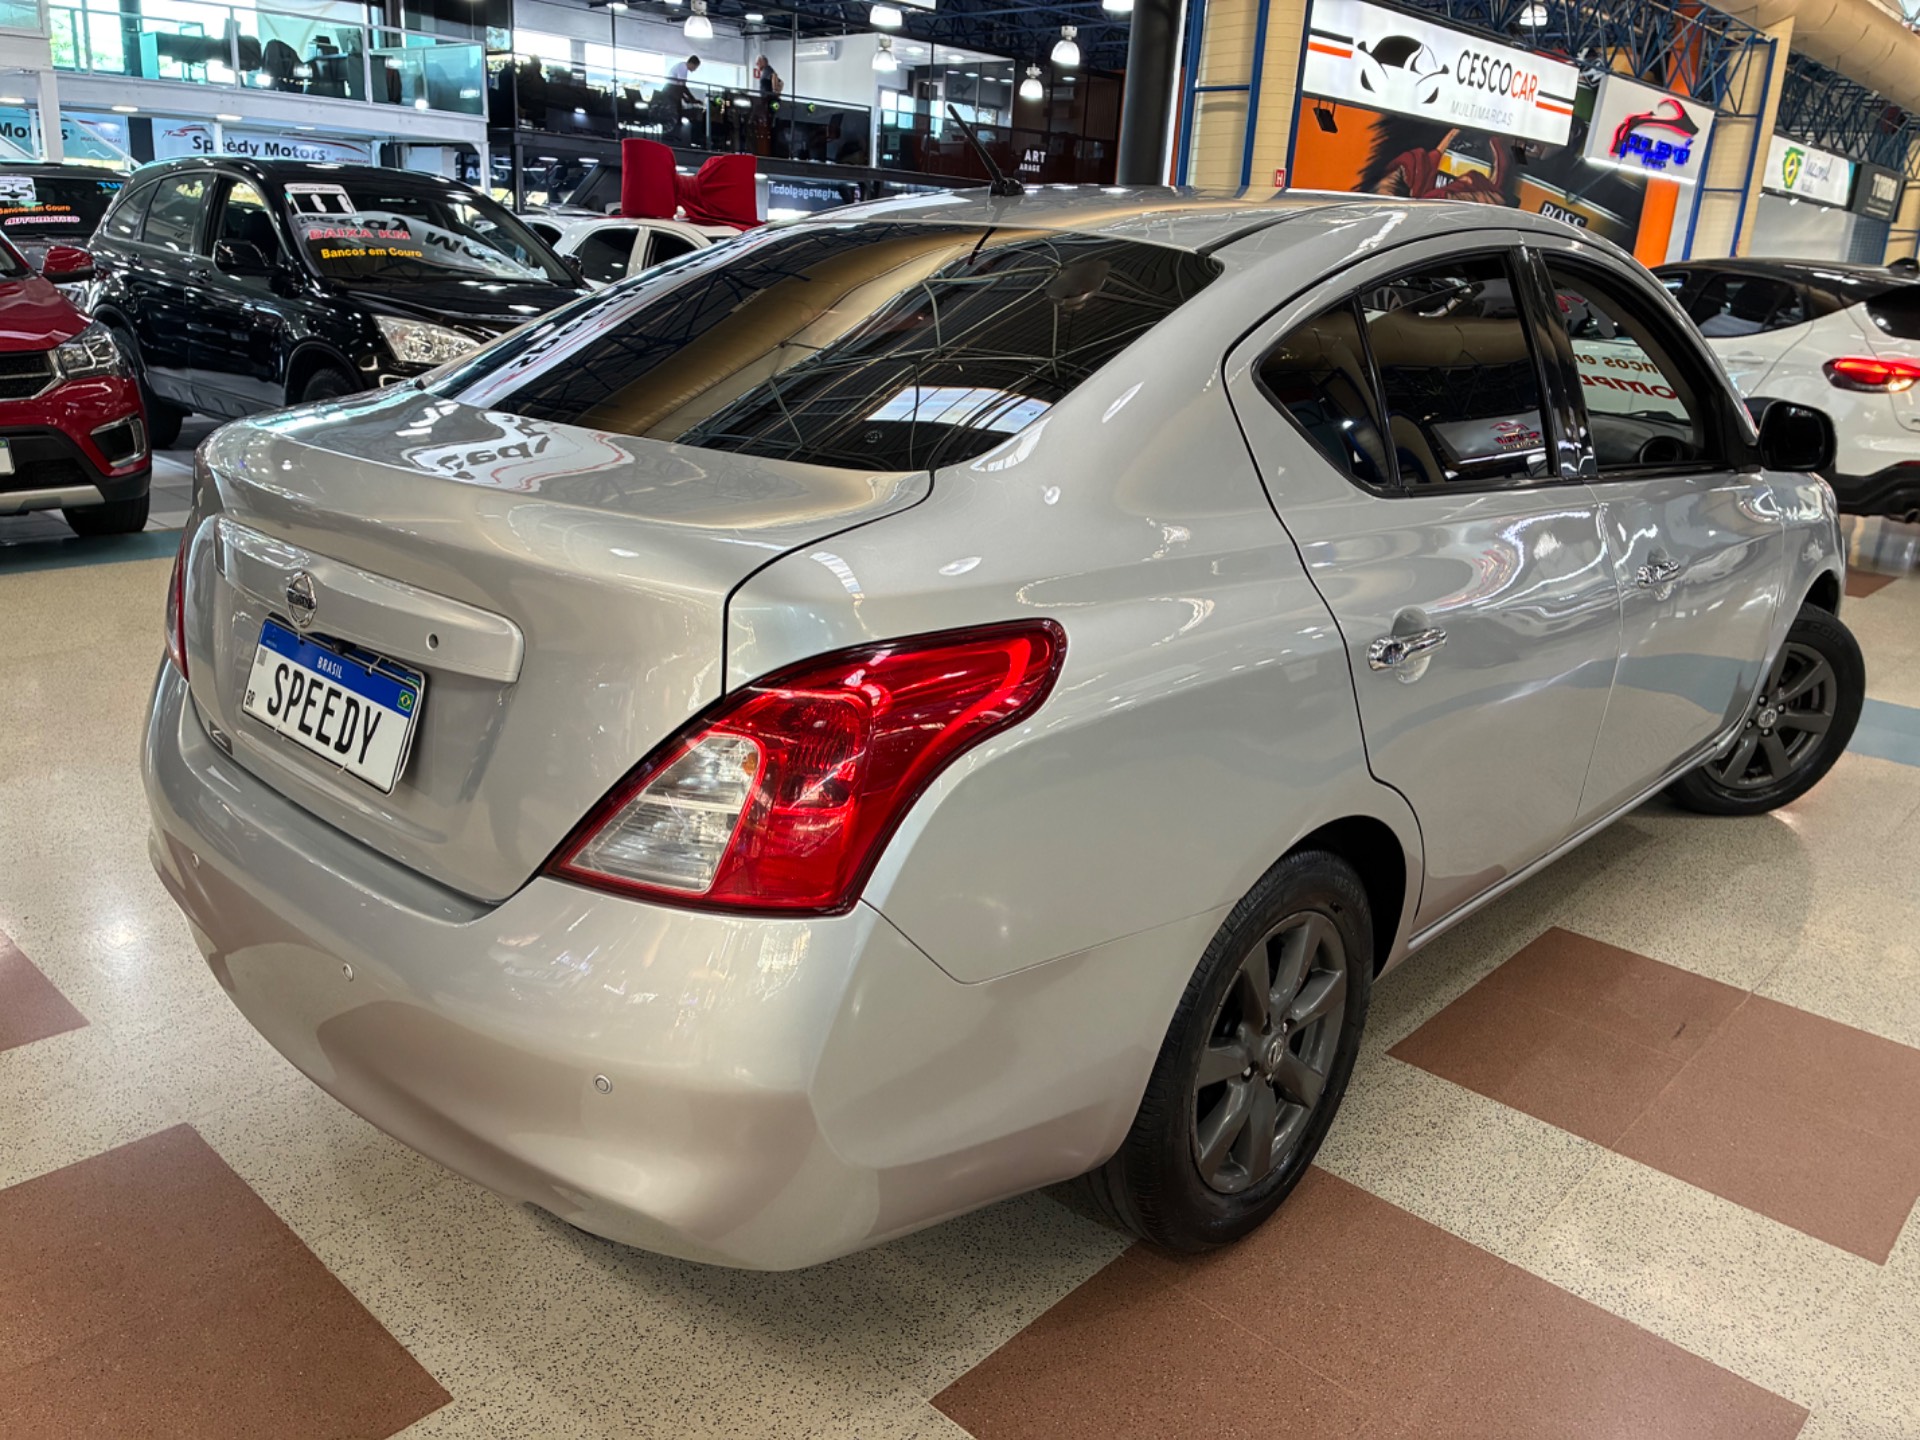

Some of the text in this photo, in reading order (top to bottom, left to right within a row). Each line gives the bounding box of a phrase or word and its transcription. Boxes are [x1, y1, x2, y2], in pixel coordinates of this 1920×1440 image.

[1456, 49, 1538, 103] CESCOCAR
[192, 135, 326, 161] Spedy Motors
[1024, 149, 1047, 163] ART
[309, 229, 411, 241] BAIXA KM
[321, 247, 423, 259] Bancos em Couro
[316, 655, 343, 680] BRASIL
[267, 662, 383, 765] SPEEDY
